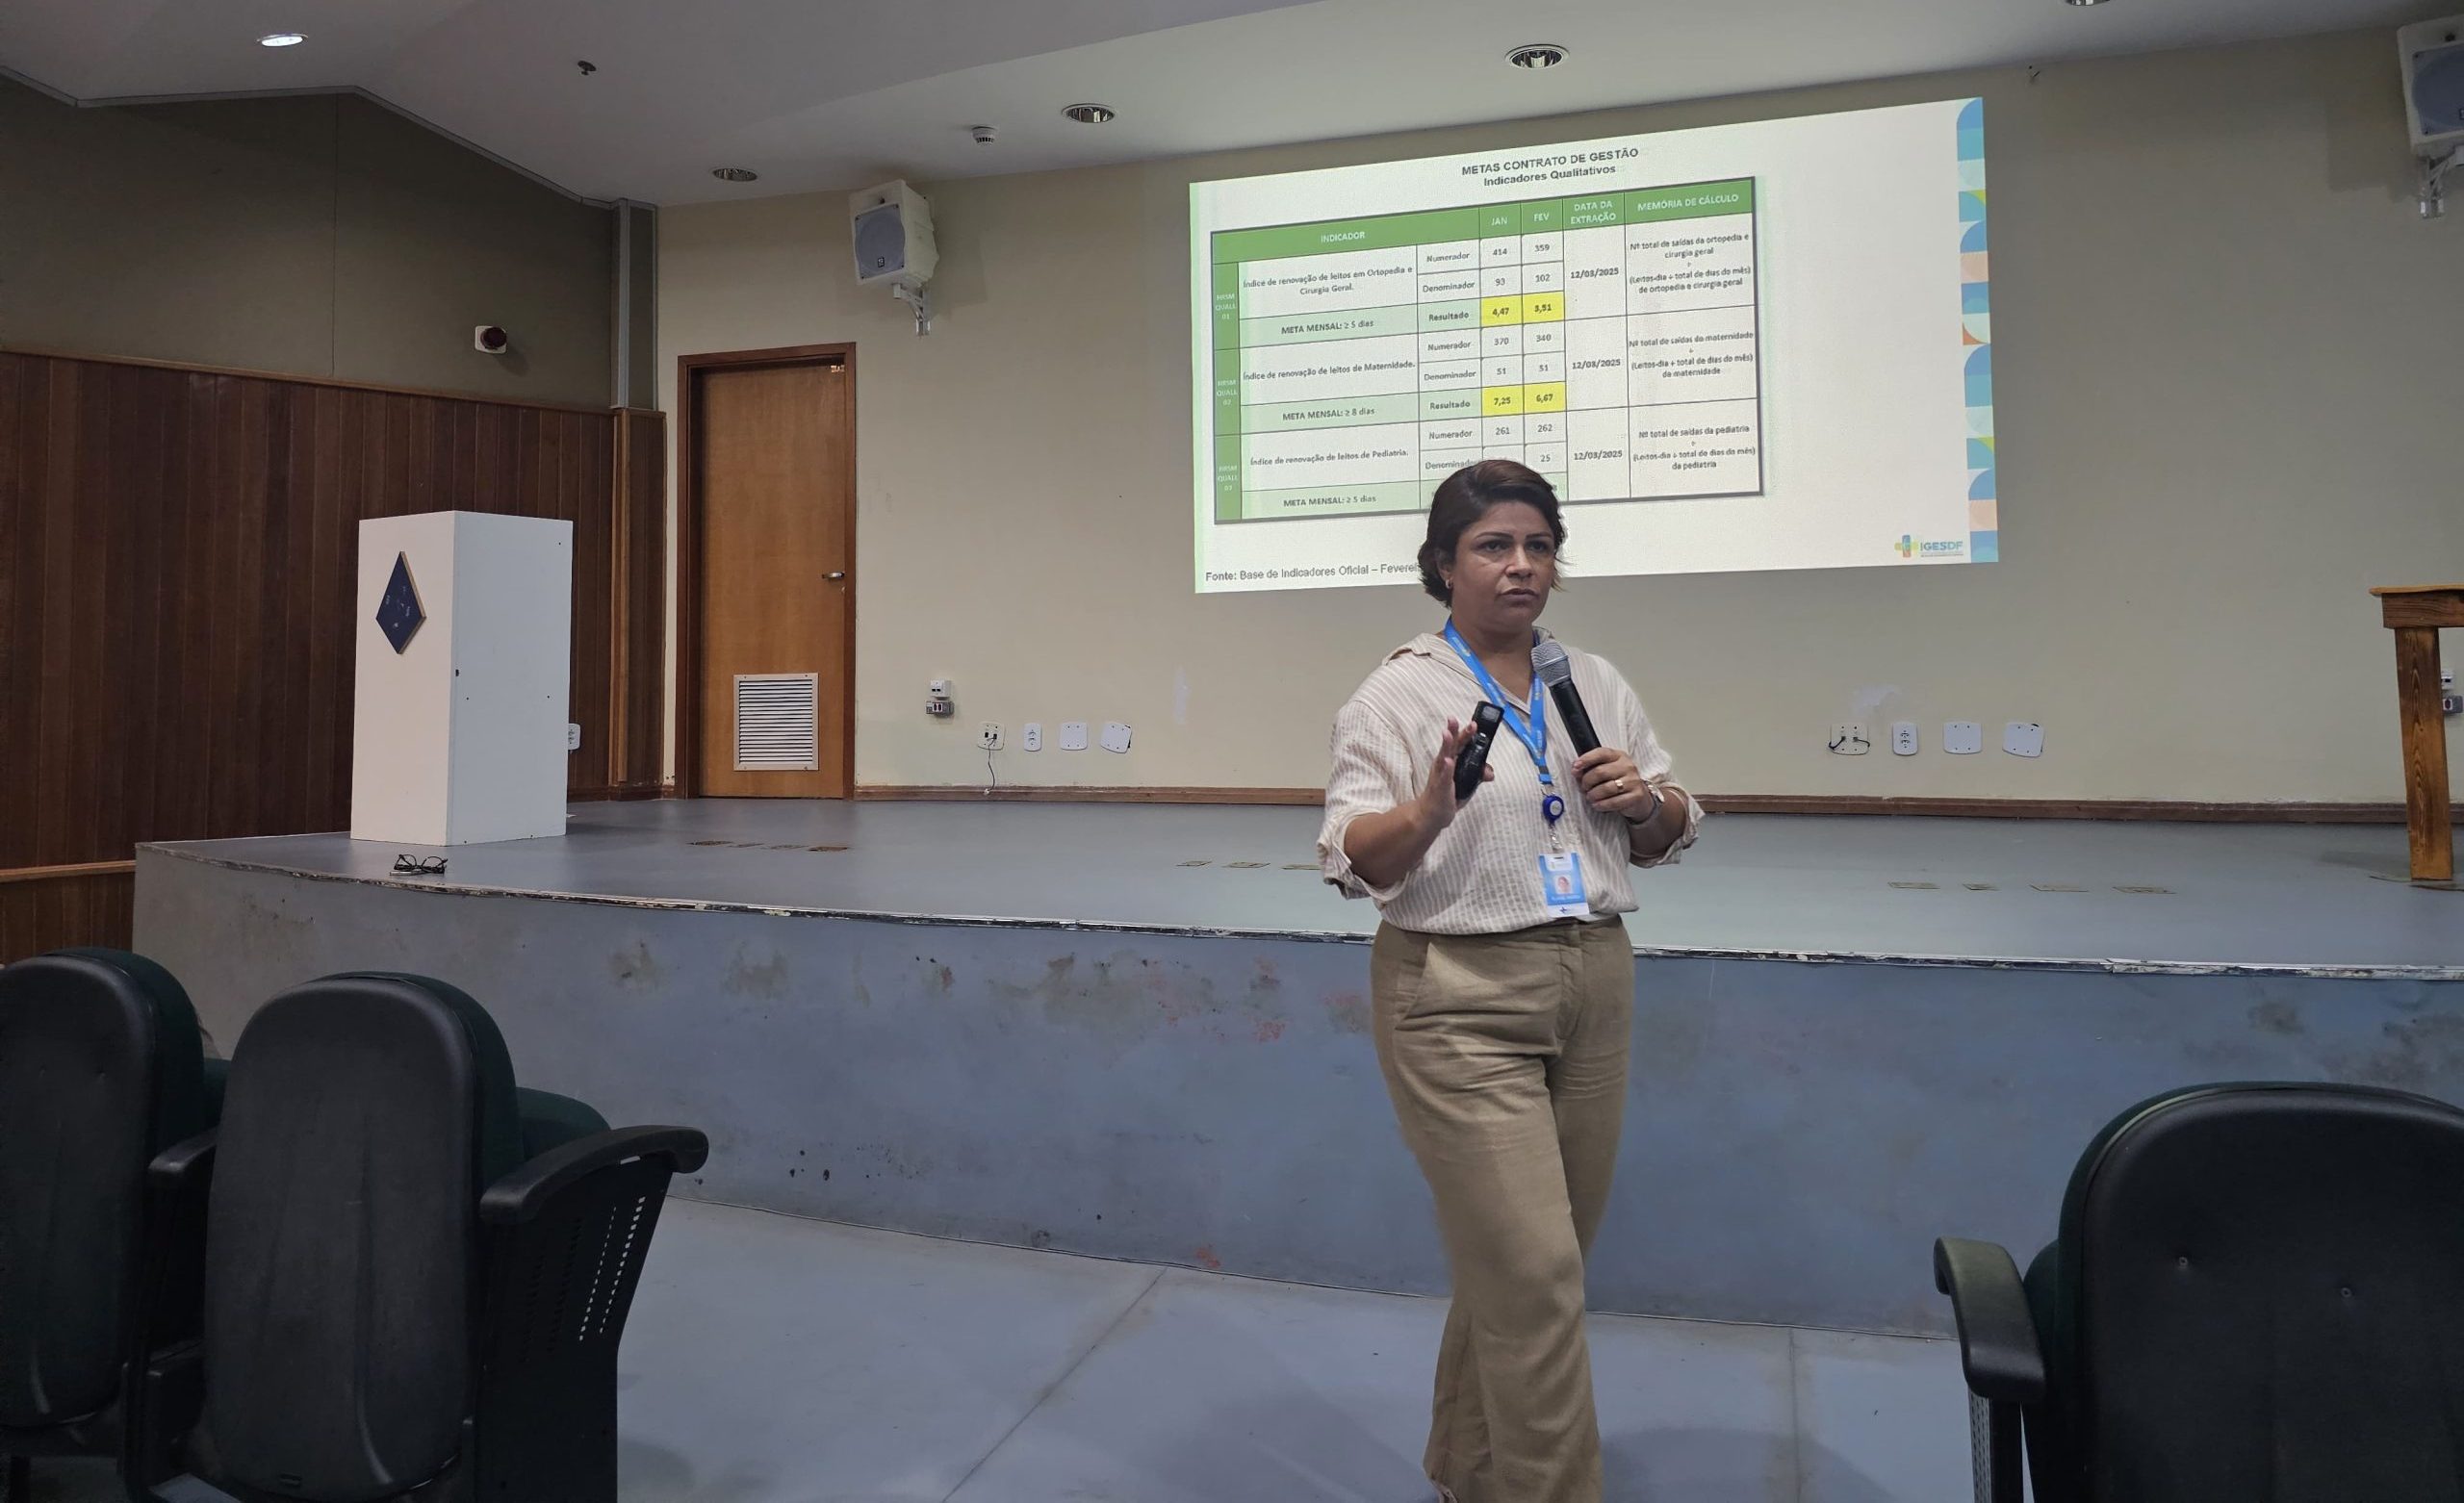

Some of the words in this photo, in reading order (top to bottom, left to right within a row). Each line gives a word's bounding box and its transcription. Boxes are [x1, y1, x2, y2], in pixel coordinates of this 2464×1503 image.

[1461, 164, 1501, 176] METAS
[1503, 156, 1567, 170] CONTRATO
[1570, 153, 1586, 165] DE
[1589, 147, 1639, 162] GESTÃO
[1483, 172, 1548, 187] Indicadores
[1550, 165, 1616, 180] Qualitativos
[1574, 202, 1598, 212] DATA
[1600, 200, 1613, 209] DA
[1637, 198, 1682, 212] MEMÓRIA
[1684, 198, 1697, 207] DE
[1698, 192, 1739, 206] CÁLCULO
[1491, 217, 1508, 226] JAN
[1533, 213, 1550, 223] FEV
[1570, 212, 1617, 225] EXTRAÇÃO
[1320, 231, 1366, 242] INDICADOR
[1641, 240, 1660, 251] total
[1660, 239, 1670, 248] de
[1671, 236, 1694, 248] saídas
[1695, 235, 1705, 245] da
[1706, 233, 1743, 245] ortopedia
[1492, 247, 1508, 257] 414
[1534, 243, 1551, 253] 359
[1664, 248, 1694, 260] cirurgia
[1694, 246, 1715, 259] geral
[1425, 251, 1471, 264] Numerador
[1243, 279, 1266, 289] Índice
[1267, 277, 1277, 287] de
[1278, 272, 1318, 287] renovação
[1319, 272, 1328, 281] de
[1329, 270, 1351, 281] leitos
[1352, 270, 1366, 279] em
[1366, 265, 1405, 279] Ortopedia
[1534, 272, 1551, 283] 102
[1570, 267, 1619, 280] 12/03/2025
[1675, 270, 1693, 281] total
[1694, 269, 1704, 279] de
[1705, 268, 1720, 278] dias
[1720, 267, 1732, 276] do
[1732, 266, 1752, 276] mês)
[1422, 280, 1476, 293] Denominador
[1495, 277, 1506, 287] 93
[1638, 286, 1648, 294] de
[1649, 282, 1686, 293] ortopedia
[1693, 280, 1721, 291] cirurgia
[1722, 277, 1743, 290] geral
[1299, 286, 1329, 296] Cirurgia
[1428, 312, 1470, 322] Resultado
[1492, 307, 1510, 318] 4,47
[1281, 326, 1305, 336] META
[1306, 321, 1343, 333] MENSAL:
[1350, 320, 1356, 329] 5
[1357, 319, 1374, 329] dias
[1427, 341, 1472, 352] Numerador
[1494, 337, 1509, 346] 370
[1640, 337, 1658, 347] total
[1659, 336, 1670, 345] de
[1677, 357, 1695, 368] total
[1696, 357, 1707, 366] de
[1707, 355, 1723, 365] dias
[1723, 354, 1733, 363] do
[1243, 371, 1266, 381] Índice
[1277, 367, 1317, 378] renovação
[1318, 367, 1328, 375] de
[1329, 365, 1350, 374] leitos
[1352, 364, 1363, 372] de
[1364, 360, 1416, 371] Maternidade.
[1424, 369, 1477, 381] Denominador
[1497, 368, 1506, 376] 51
[1539, 365, 1549, 373] 51
[1673, 367, 1721, 378] maternidade
[1536, 393, 1553, 404] 6,67
[1430, 399, 1471, 411] Resultado
[1282, 412, 1306, 421] META
[1307, 408, 1344, 419] MENSAL:
[1351, 408, 1357, 417] 8
[1358, 407, 1375, 417] dias
[1496, 426, 1510, 436] 261
[1537, 422, 1553, 433] 262
[1650, 427, 1669, 439] total
[1670, 428, 1680, 437] de
[1704, 425, 1714, 435] da
[1715, 423, 1750, 436] pediatria
[1429, 429, 1473, 441] Numerador
[1251, 456, 1272, 466] Índice
[1274, 456, 1285, 465] de
[1286, 452, 1324, 464] renovação
[1326, 452, 1336, 461] de
[1337, 450, 1359, 461] leitos
[1360, 449, 1371, 459] de
[1372, 447, 1409, 458] Pediatria.
[1540, 453, 1551, 462] 25
[1679, 449, 1697, 459] total
[1709, 446, 1725, 457] dias
[1725, 446, 1735, 455] do
[1682, 459, 1717, 471] pediatria
[1283, 497, 1306, 507] META
[1308, 495, 1344, 505] MENSAL:
[1352, 495, 1358, 503] 5
[1359, 494, 1376, 502] dias
[1920, 540, 1964, 551] IGESDF
[1205, 571, 1237, 582] Fonte:
[1239, 569, 1265, 580] Base
[1266, 568, 1279, 579] de
[1281, 564, 1336, 578] Indicadores
[1338, 564, 1369, 576] Oficial
